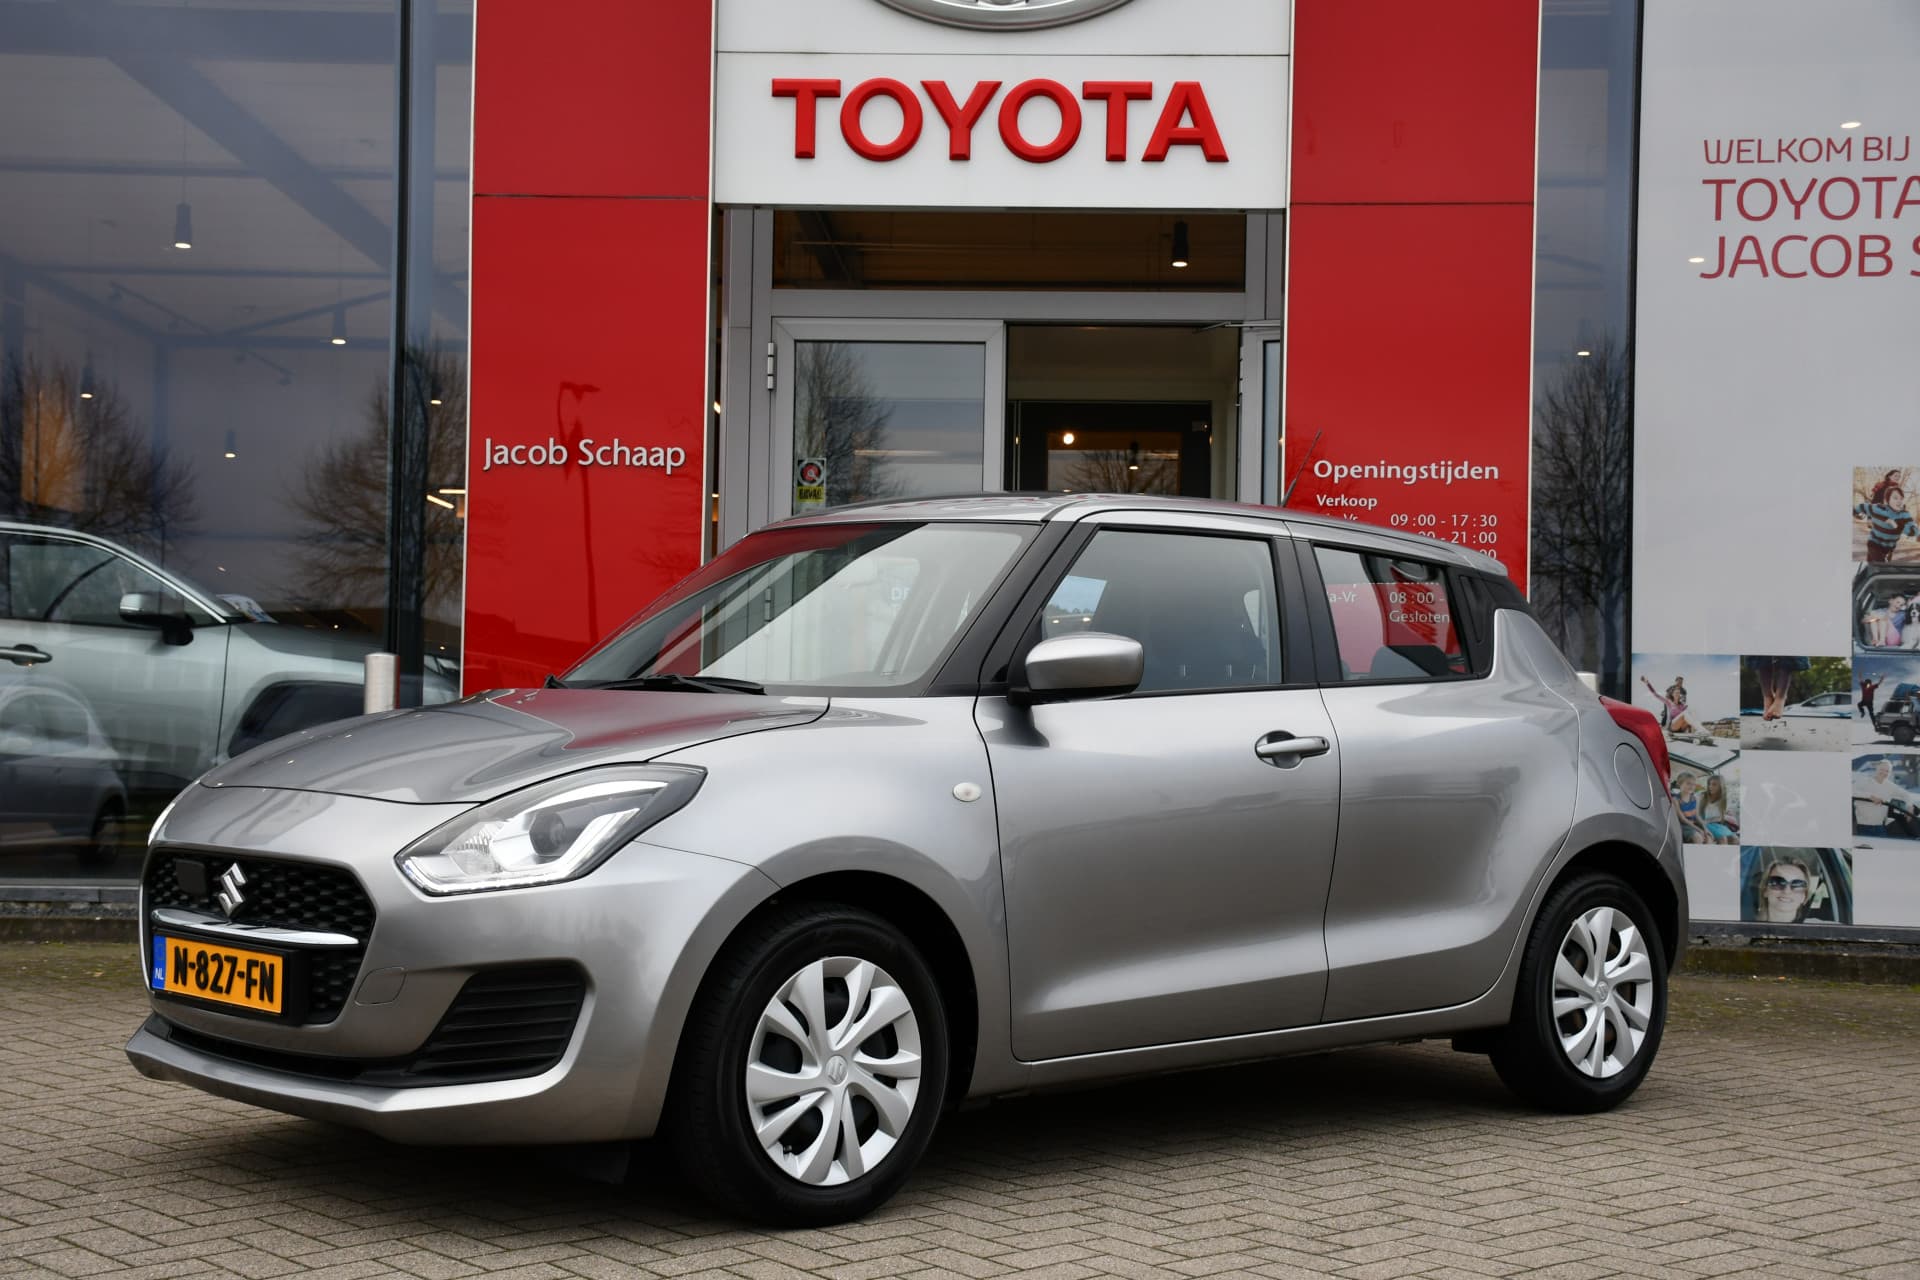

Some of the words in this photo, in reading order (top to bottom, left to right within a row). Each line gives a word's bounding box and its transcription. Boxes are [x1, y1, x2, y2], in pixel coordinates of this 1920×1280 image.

[772, 77, 1229, 163] TOYOTA
[1703, 137, 1852, 164] WELKOM
[1863, 135, 1910, 162] BIJ
[1702, 175, 1920, 222] TOYOTA
[1699, 234, 1893, 279] JACOB
[483, 437, 568, 471] Jacob
[578, 438, 686, 475] Schaap
[1313, 460, 1499, 485] Openingstijden
[1316, 494, 1378, 510] Verkoop
[1389, 610, 1450, 623] Gesloten
[154, 967, 164, 980] NL
[173, 946, 275, 1004] N-827-FN
